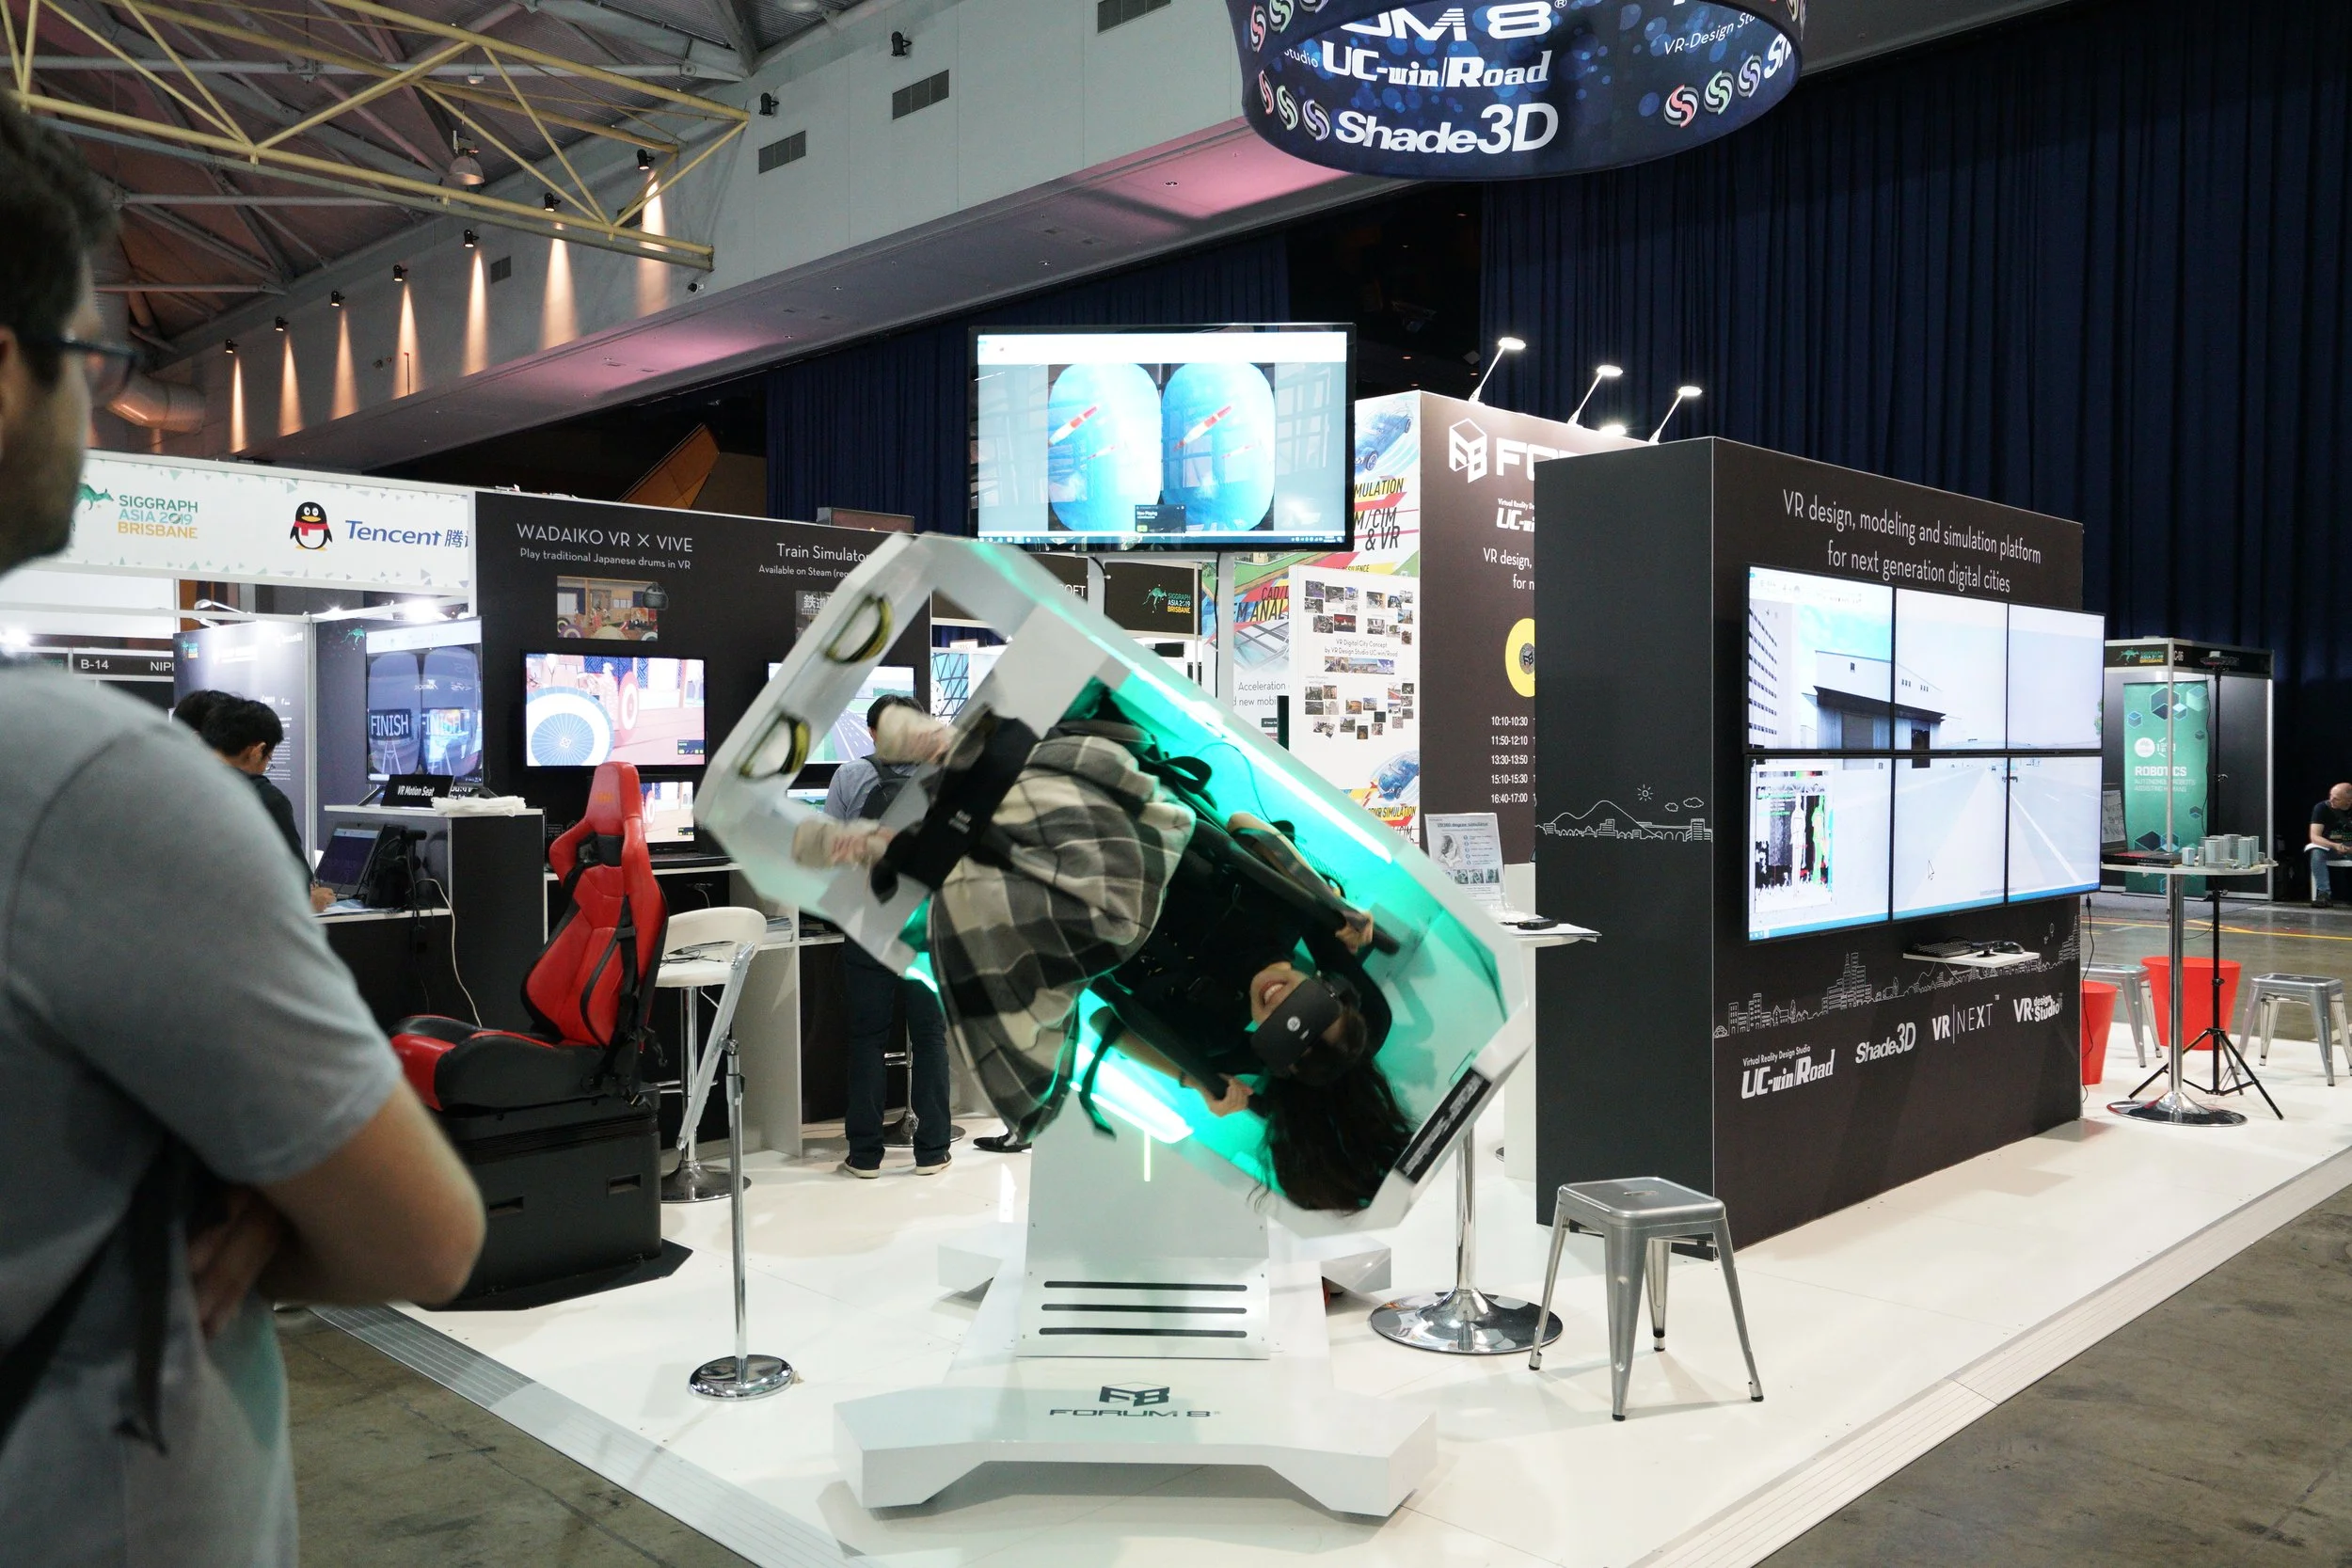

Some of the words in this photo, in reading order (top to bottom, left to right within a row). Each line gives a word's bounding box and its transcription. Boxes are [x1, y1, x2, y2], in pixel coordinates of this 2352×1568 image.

[1664, 24, 1734, 55] VR-Design
[1335, 103, 1559, 154] Shade3D
[119, 495, 198, 514] SIGGRAPH
[119, 509, 155, 523] ASIA
[159, 512, 193, 525] 2019
[118, 521, 199, 539] BRISBANE
[345, 520, 442, 546] Tencent
[1783, 489, 1804, 518] VR
[1808, 494, 1855, 532] design,
[1860, 509, 1915, 546] modeling
[1919, 519, 1940, 544] and
[1943, 525, 1997, 553] simulation
[2000, 534, 2041, 564] platform
[516, 523, 604, 545] WADAIKO
[609, 531, 630, 547] VR
[656, 534, 693, 552] VIVE
[1381, 526, 1401, 549] VR
[520, 547, 541, 562] Play
[543, 549, 591, 562] traditional
[594, 554, 636, 565] Japanese
[638, 557, 666, 568] drums
[667, 560, 675, 569] in
[677, 560, 691, 570] VR
[776, 543, 809, 559] Train
[1483, 547, 1498, 563] VR
[1500, 549, 1533, 570] design,
[758, 564, 795, 576] Available
[807, 566, 832, 577] Steam
[1828, 539, 1847, 567] for
[1851, 550, 1879, 573] next
[1883, 559, 1945, 582] generation
[1948, 561, 1980, 592] digital
[1983, 569, 2010, 593] cities
[1513, 574, 1527, 590] for
[80, 659, 109, 670] B-14
[1238, 681, 1285, 691] Acceleration
[371, 714, 409, 736] FINISH
[1491, 716, 1529, 726] 10:10-10:30
[1491, 736, 1529, 745] 11:50-12:10
[1491, 755, 1529, 765] 13:30-13:50
[1491, 774, 1529, 784] 15:10-15:30
[1491, 793, 1529, 803] 16:40-17:00
[1855, 1022, 1916, 1064] Shade3D
[1742, 1054, 1760, 1067] Virtual
[1760, 1052, 1778, 1063] Reality
[1778, 1049, 1795, 1059] Design
[1796, 1044, 1811, 1055] Studio
[1050, 1409, 1178, 1418] FORUM
